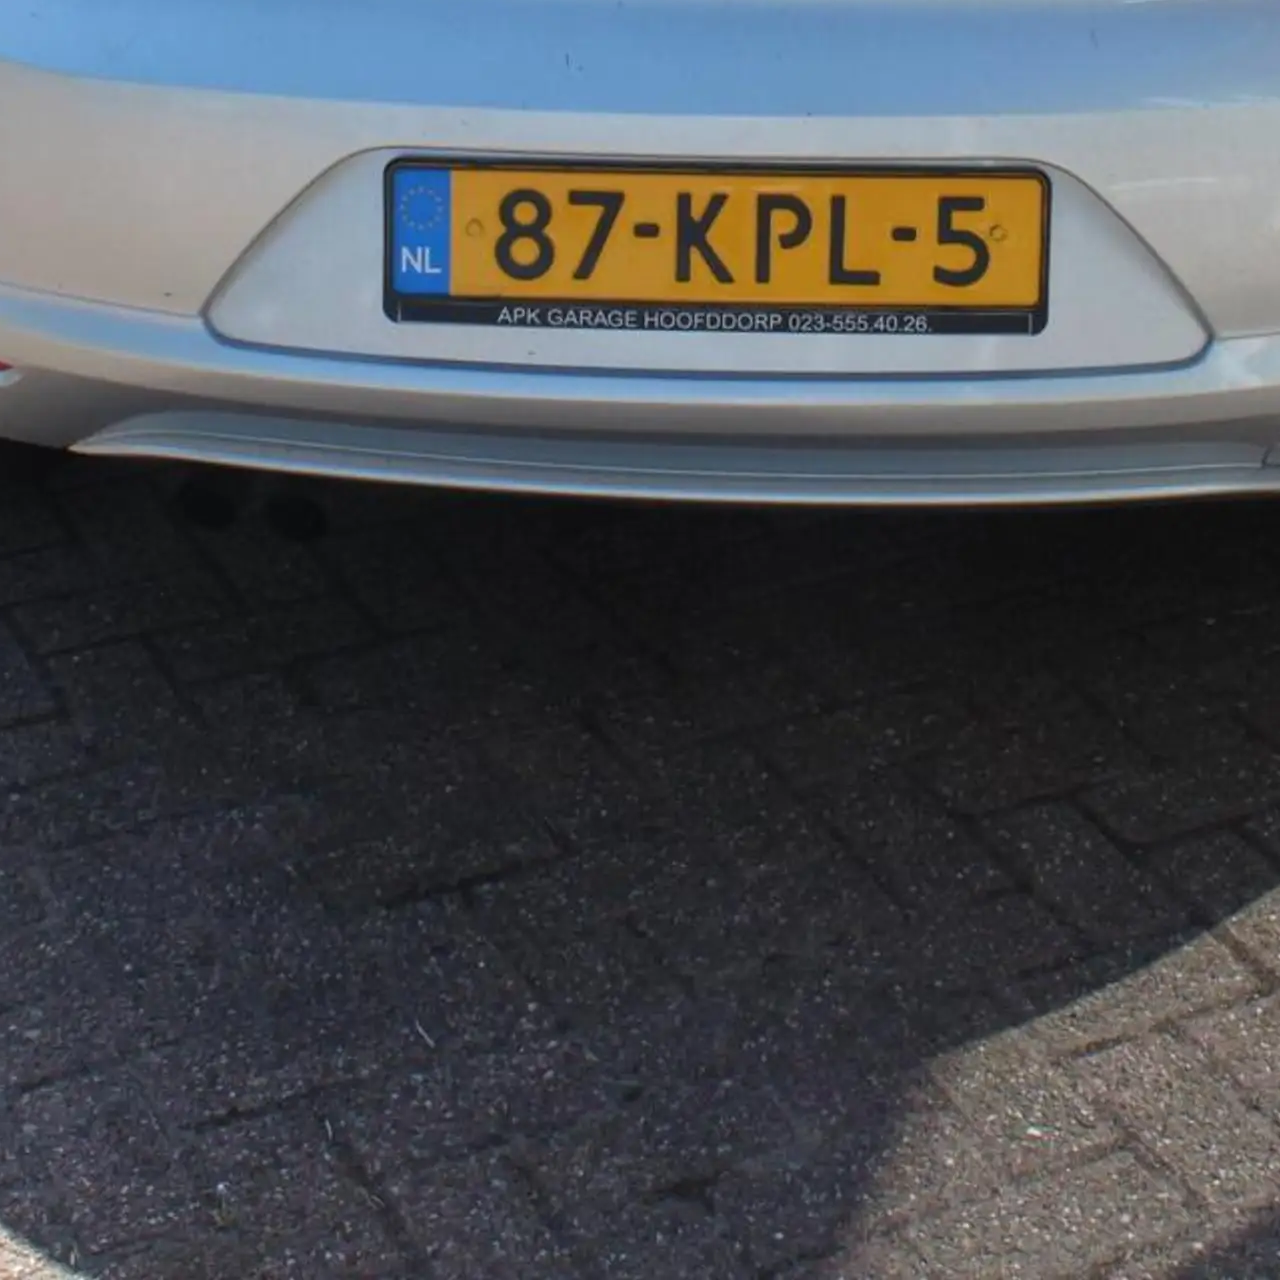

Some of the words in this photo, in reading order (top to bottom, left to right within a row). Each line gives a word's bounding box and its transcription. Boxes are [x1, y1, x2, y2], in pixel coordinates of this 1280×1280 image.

[493, 188, 991, 286] 87-KPL-5
[400, 245, 442, 275] NL
[497, 306, 541, 324] APK
[547, 308, 637, 328] GARAGE
[644, 310, 782, 331] HOOFDDORP
